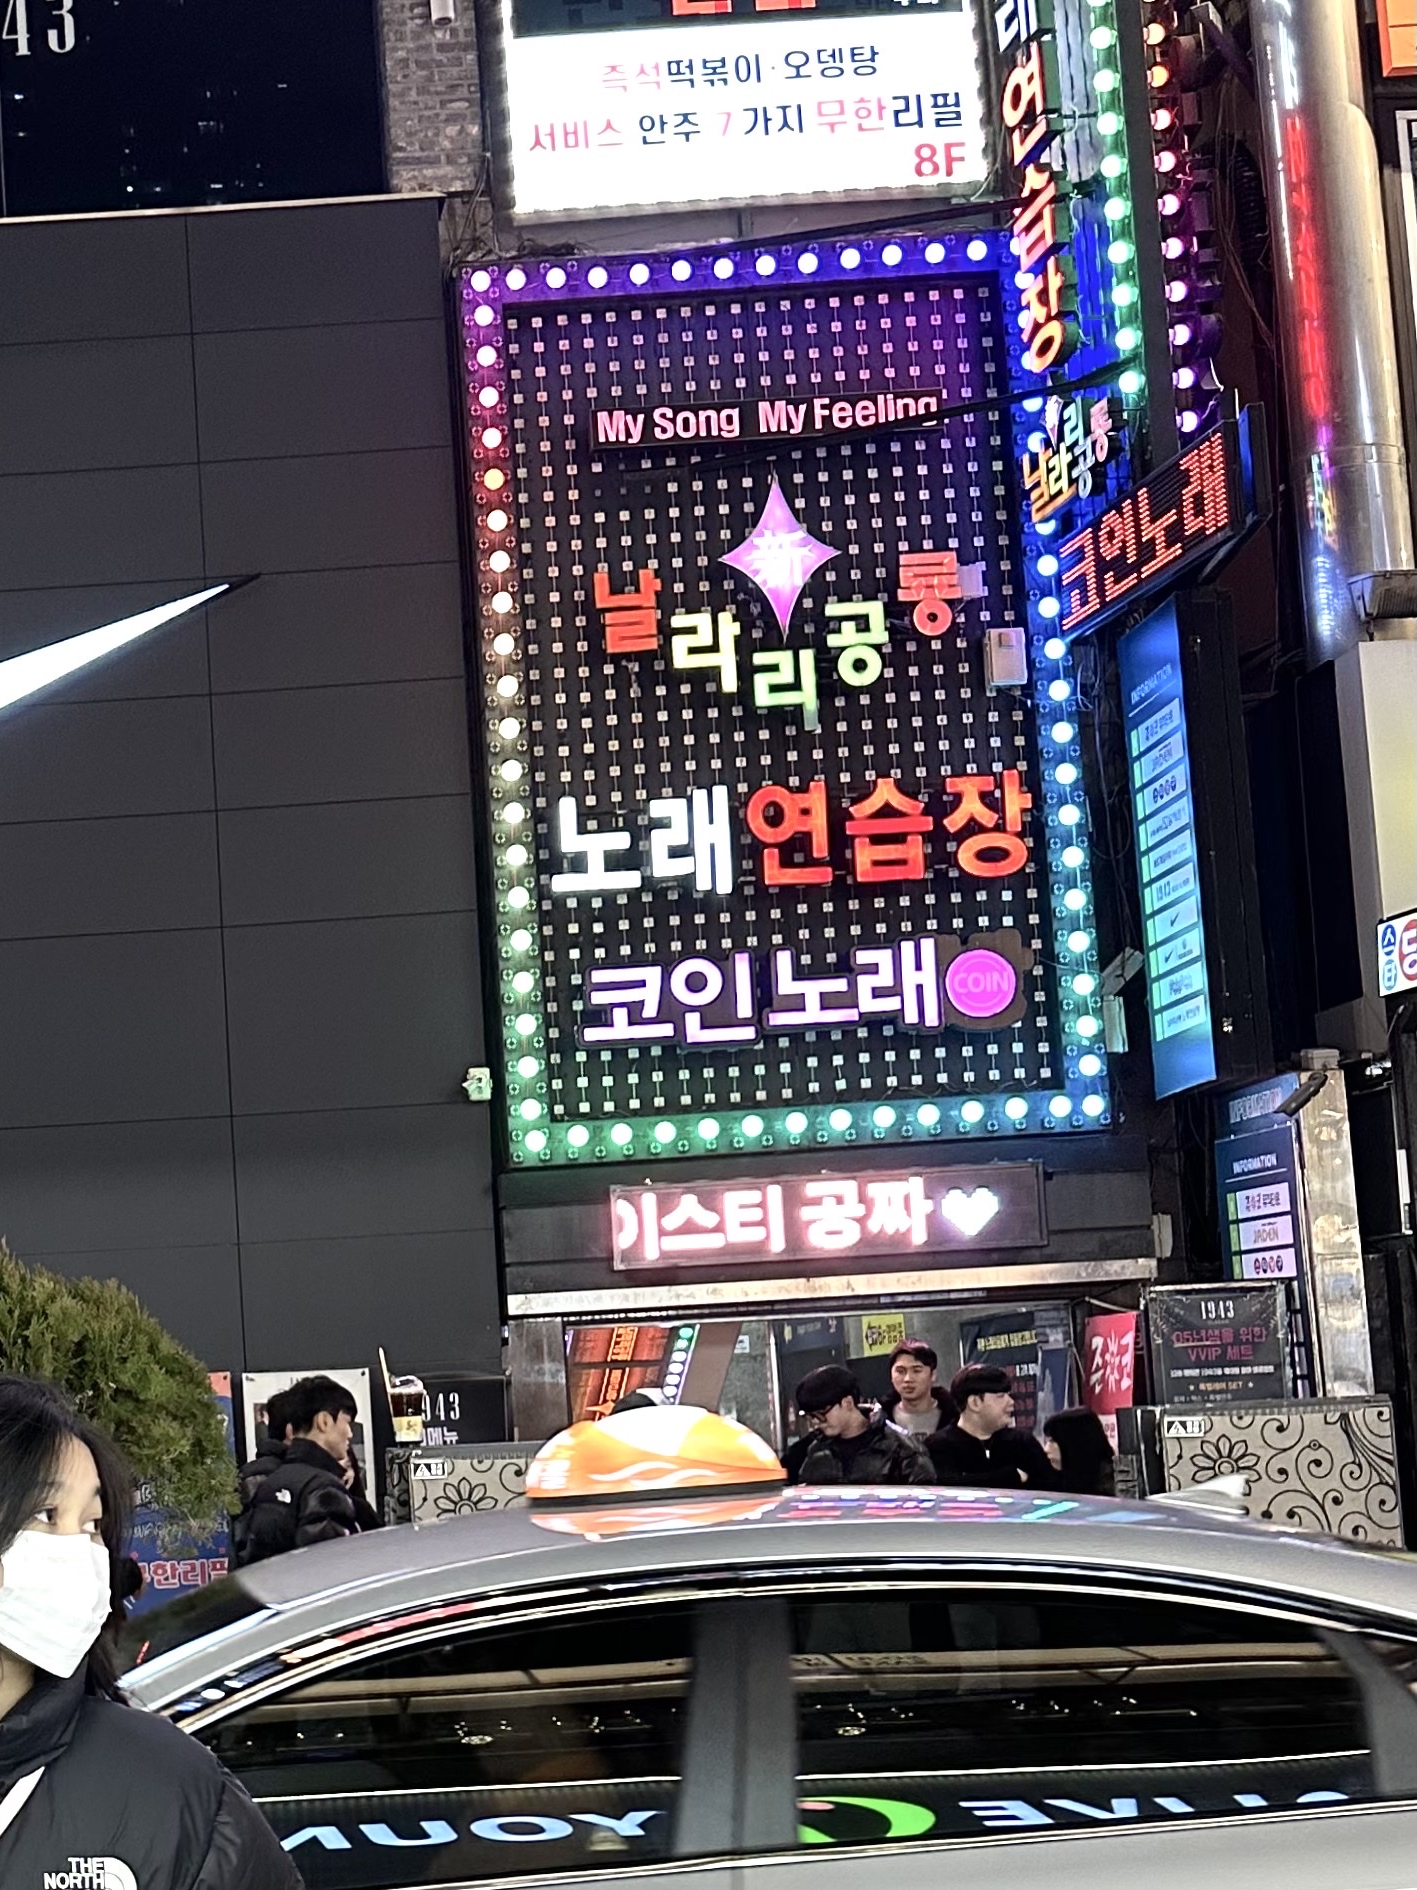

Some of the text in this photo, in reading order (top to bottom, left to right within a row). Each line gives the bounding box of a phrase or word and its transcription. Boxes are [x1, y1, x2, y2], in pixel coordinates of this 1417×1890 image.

[530, 121, 623, 152] 서비스
[638, 113, 701, 146] 안주
[815, 92, 964, 134] 무한리필
[914, 142, 966, 178] 8F
[597, 393, 938, 444] My Song My Feeling
[952, 971, 1010, 993] COIN
[1233, 1153, 1277, 1175] INFORMATION
[800, 1177, 934, 1248] 공짜
[1201, 1300, 1235, 1320] 1943
[1188, 1347, 1222, 1361] VVIP
[421, 1388, 461, 1422] 943
[138, 1557, 228, 1589] 한리
[68, 1857, 105, 1874] THE
[44, 1873, 105, 1890] NORTH
